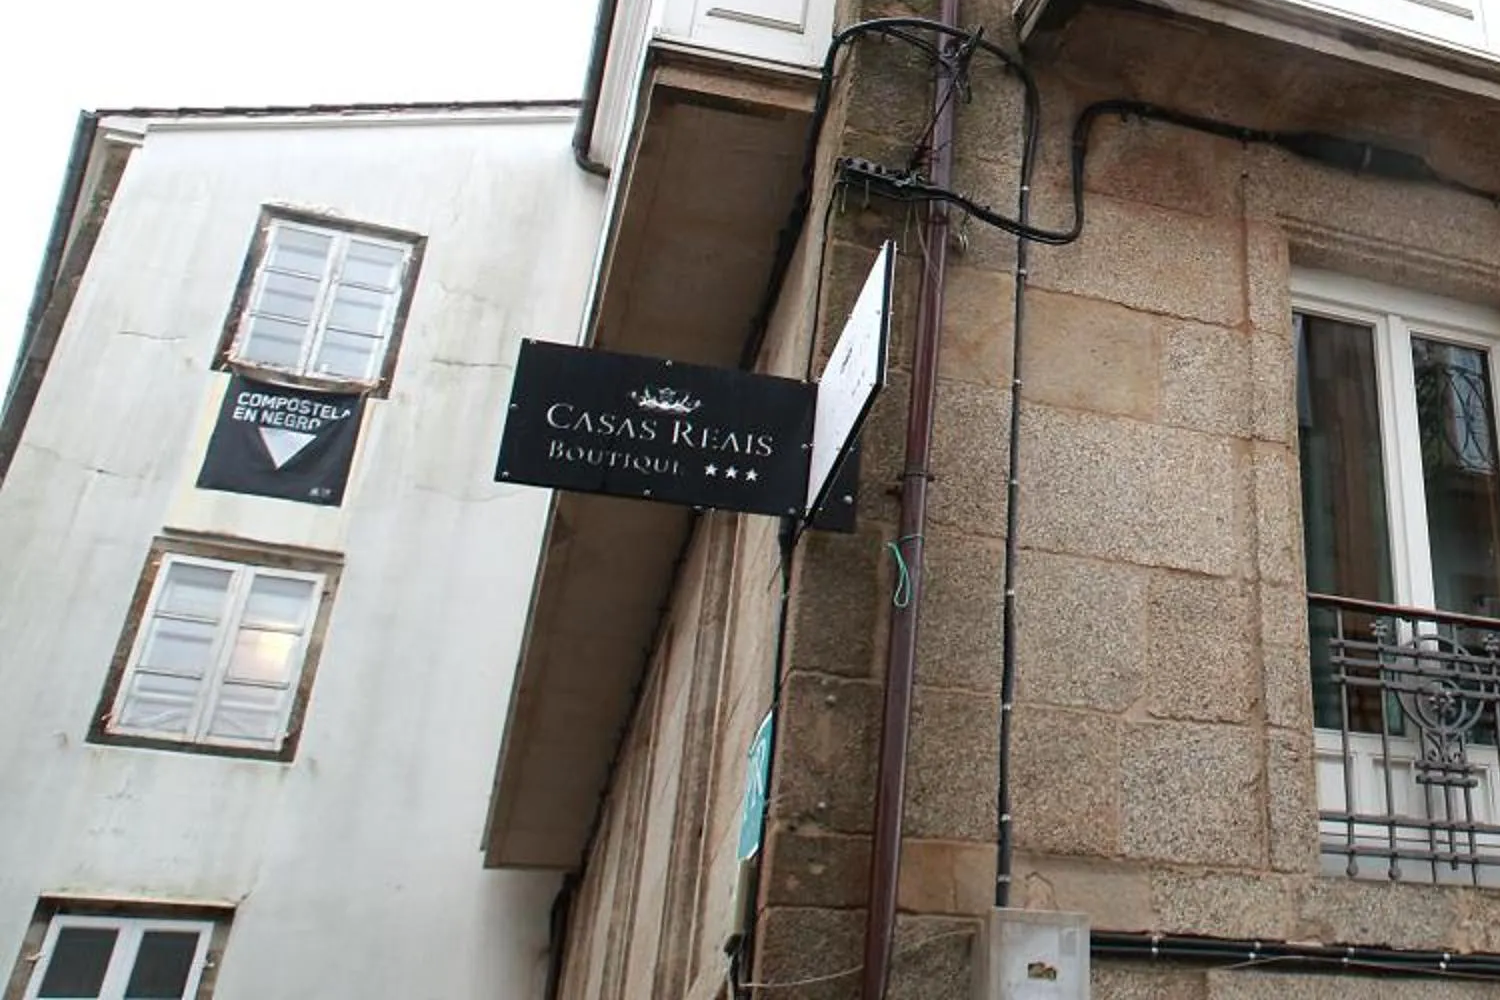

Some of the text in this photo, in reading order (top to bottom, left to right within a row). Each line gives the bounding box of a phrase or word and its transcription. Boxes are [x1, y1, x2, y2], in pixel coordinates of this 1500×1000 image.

[232, 406, 257, 423] EN
[546, 402, 774, 457] CASAS REAIS
